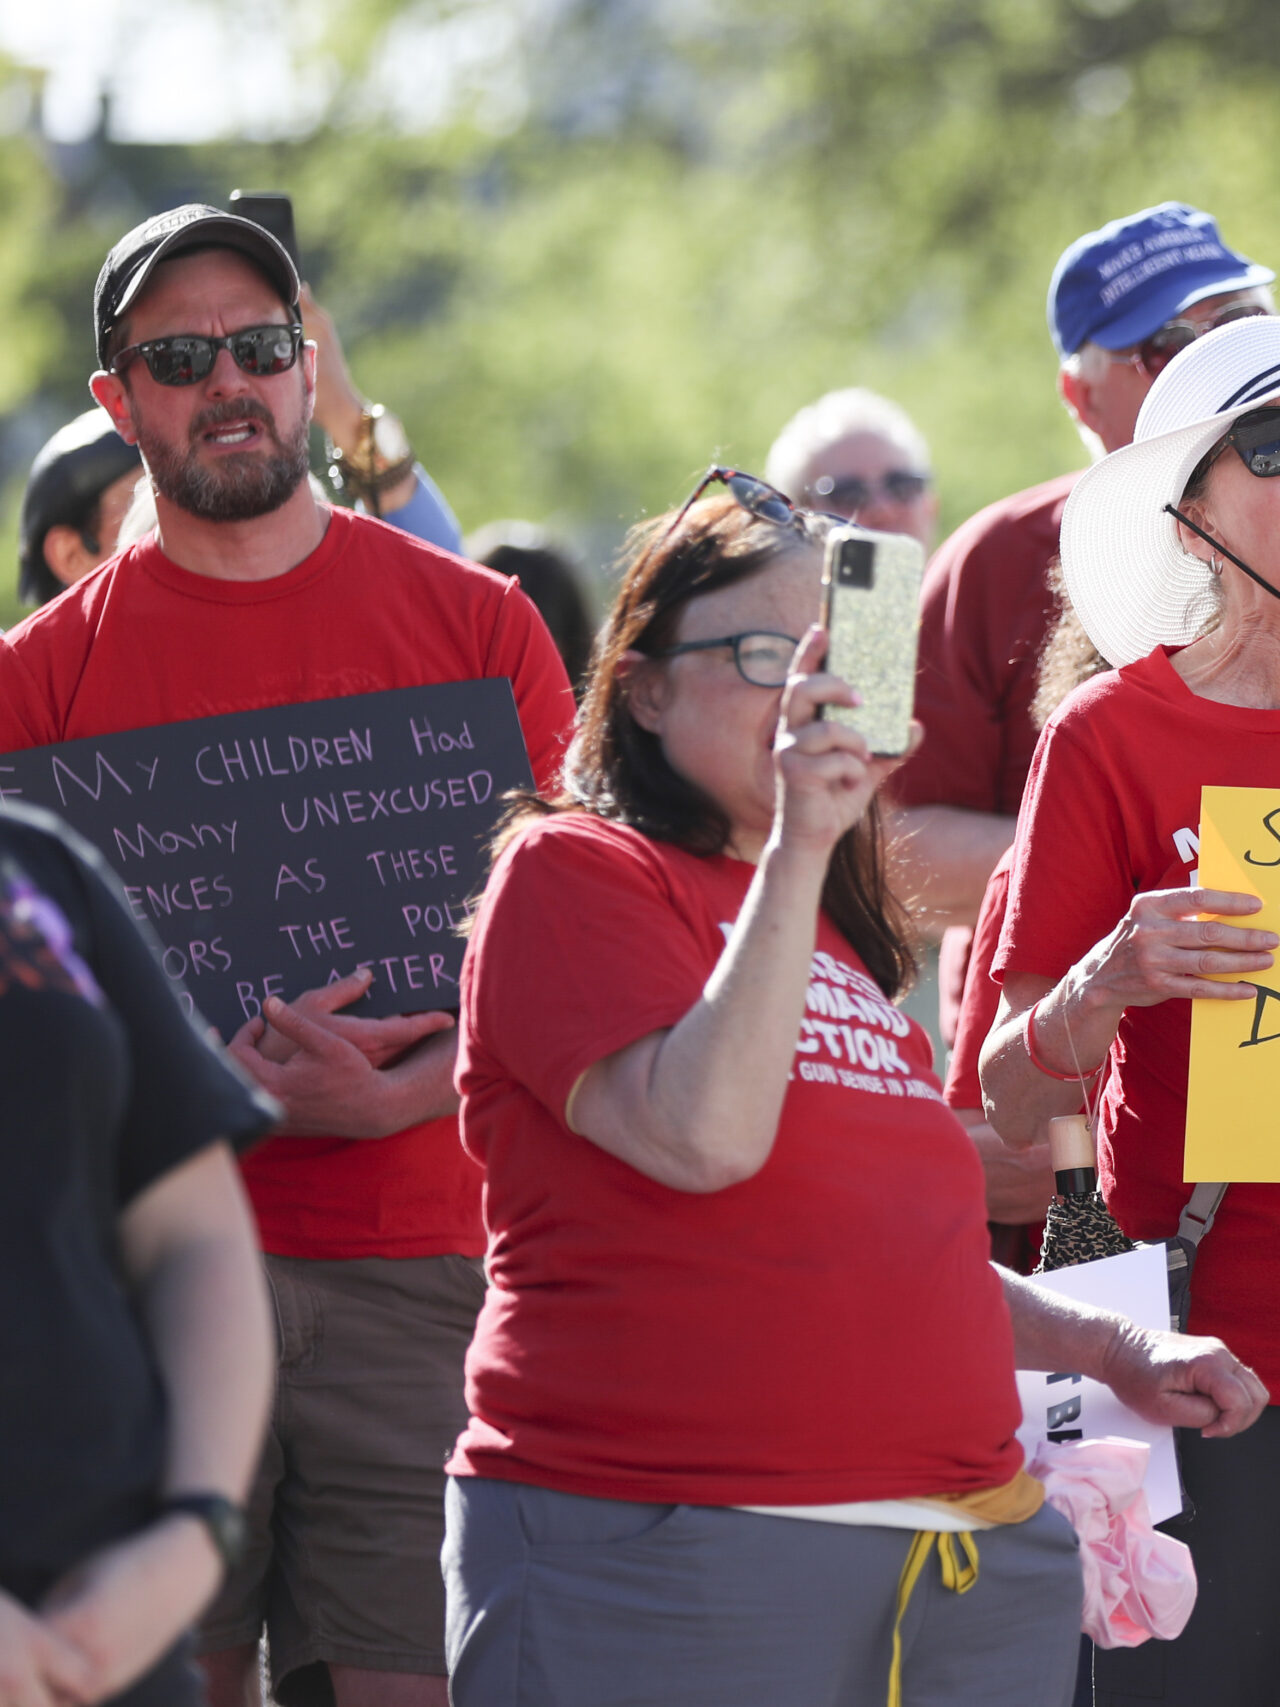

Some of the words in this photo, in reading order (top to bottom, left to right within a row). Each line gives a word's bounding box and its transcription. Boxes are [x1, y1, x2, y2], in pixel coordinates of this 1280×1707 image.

[195, 728, 373, 786] CHILDREN
[409, 717, 475, 756] Had
[281, 770, 493, 833] UNEXCUSED
[275, 858, 327, 900] AS
[366, 845, 458, 887] THESE
[280, 917, 355, 959] THE
[806, 982, 910, 1038] MAND
[796, 1018, 910, 1075] CTION
[799, 1061, 838, 1084] GUN
[837, 1069, 886, 1094] SENSE
